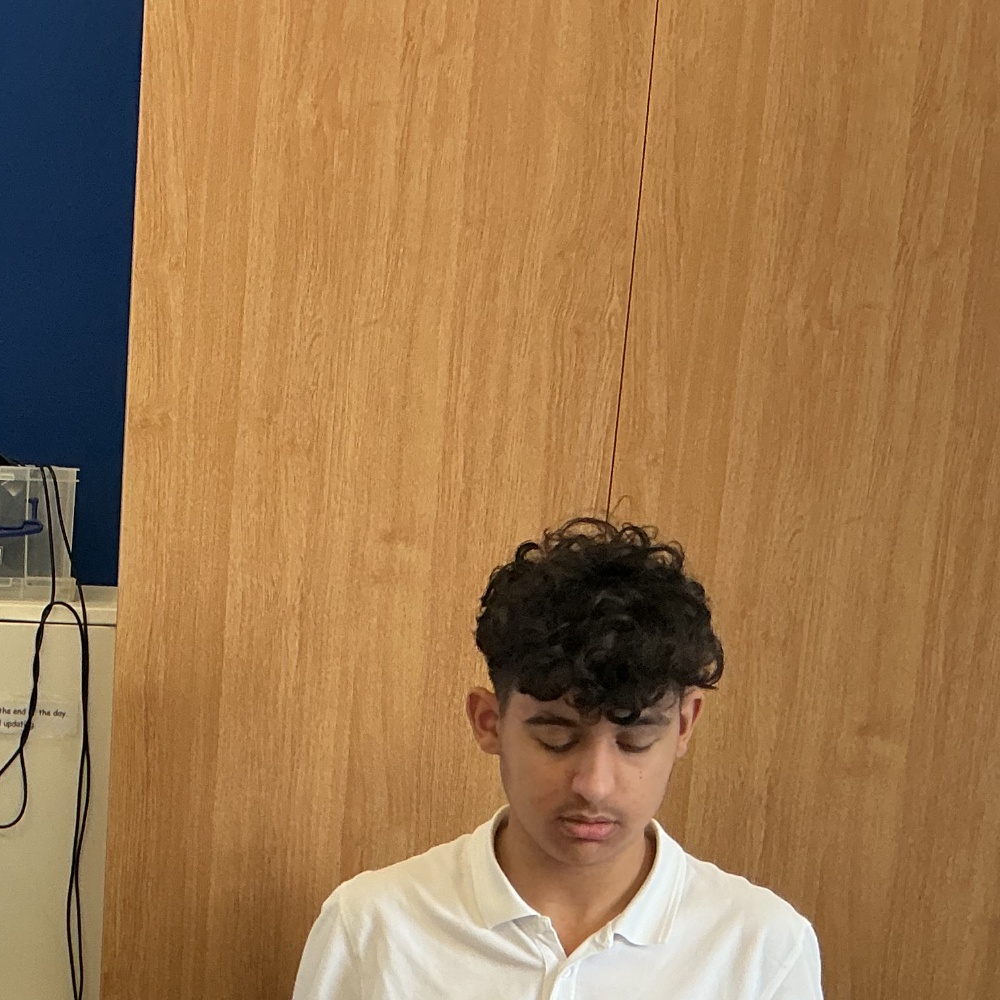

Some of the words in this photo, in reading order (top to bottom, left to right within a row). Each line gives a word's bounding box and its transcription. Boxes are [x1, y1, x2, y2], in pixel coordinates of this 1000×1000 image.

[0, 707, 11, 715] the
[13, 707, 26, 716] end
[38, 709, 52, 717] the
